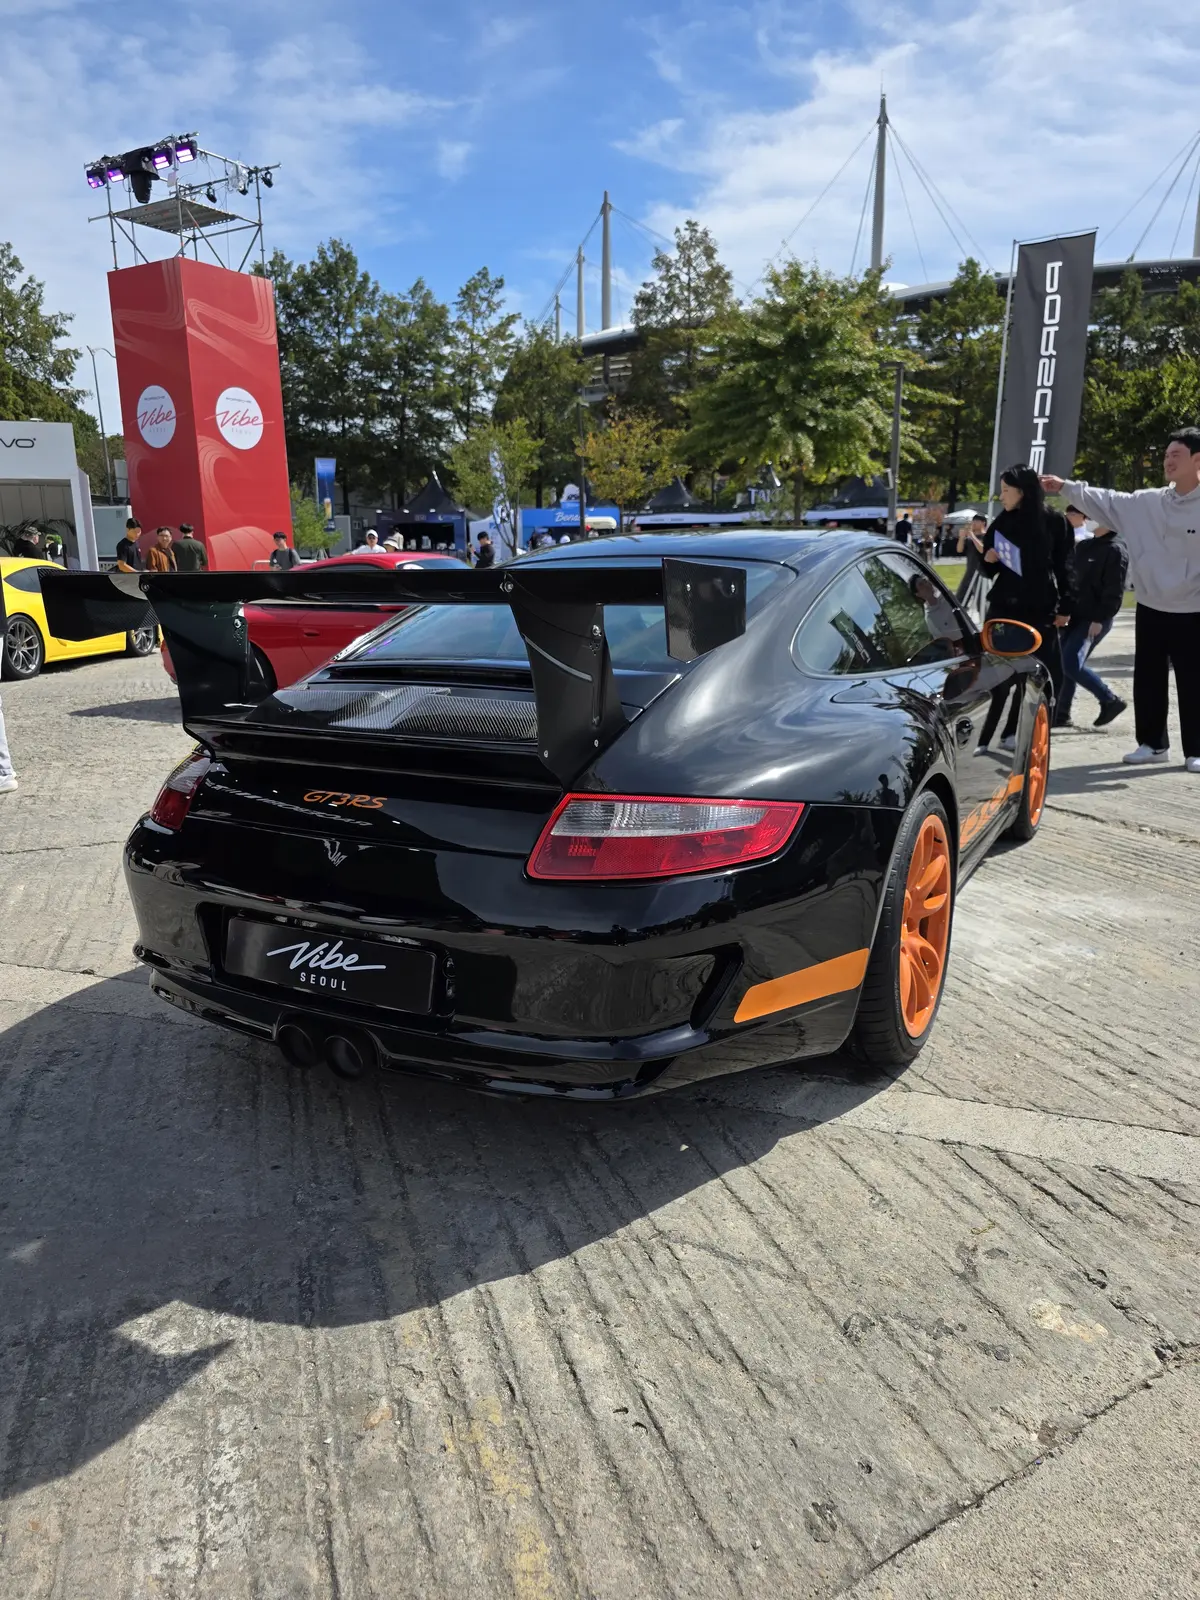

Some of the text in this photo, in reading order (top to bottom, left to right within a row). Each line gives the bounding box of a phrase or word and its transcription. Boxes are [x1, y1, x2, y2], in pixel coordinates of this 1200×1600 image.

[130, 404, 187, 431] Vibe
[204, 408, 275, 429] Vibe
[266, 940, 387, 972] Vibe
[300, 971, 347, 991] SEOUL
